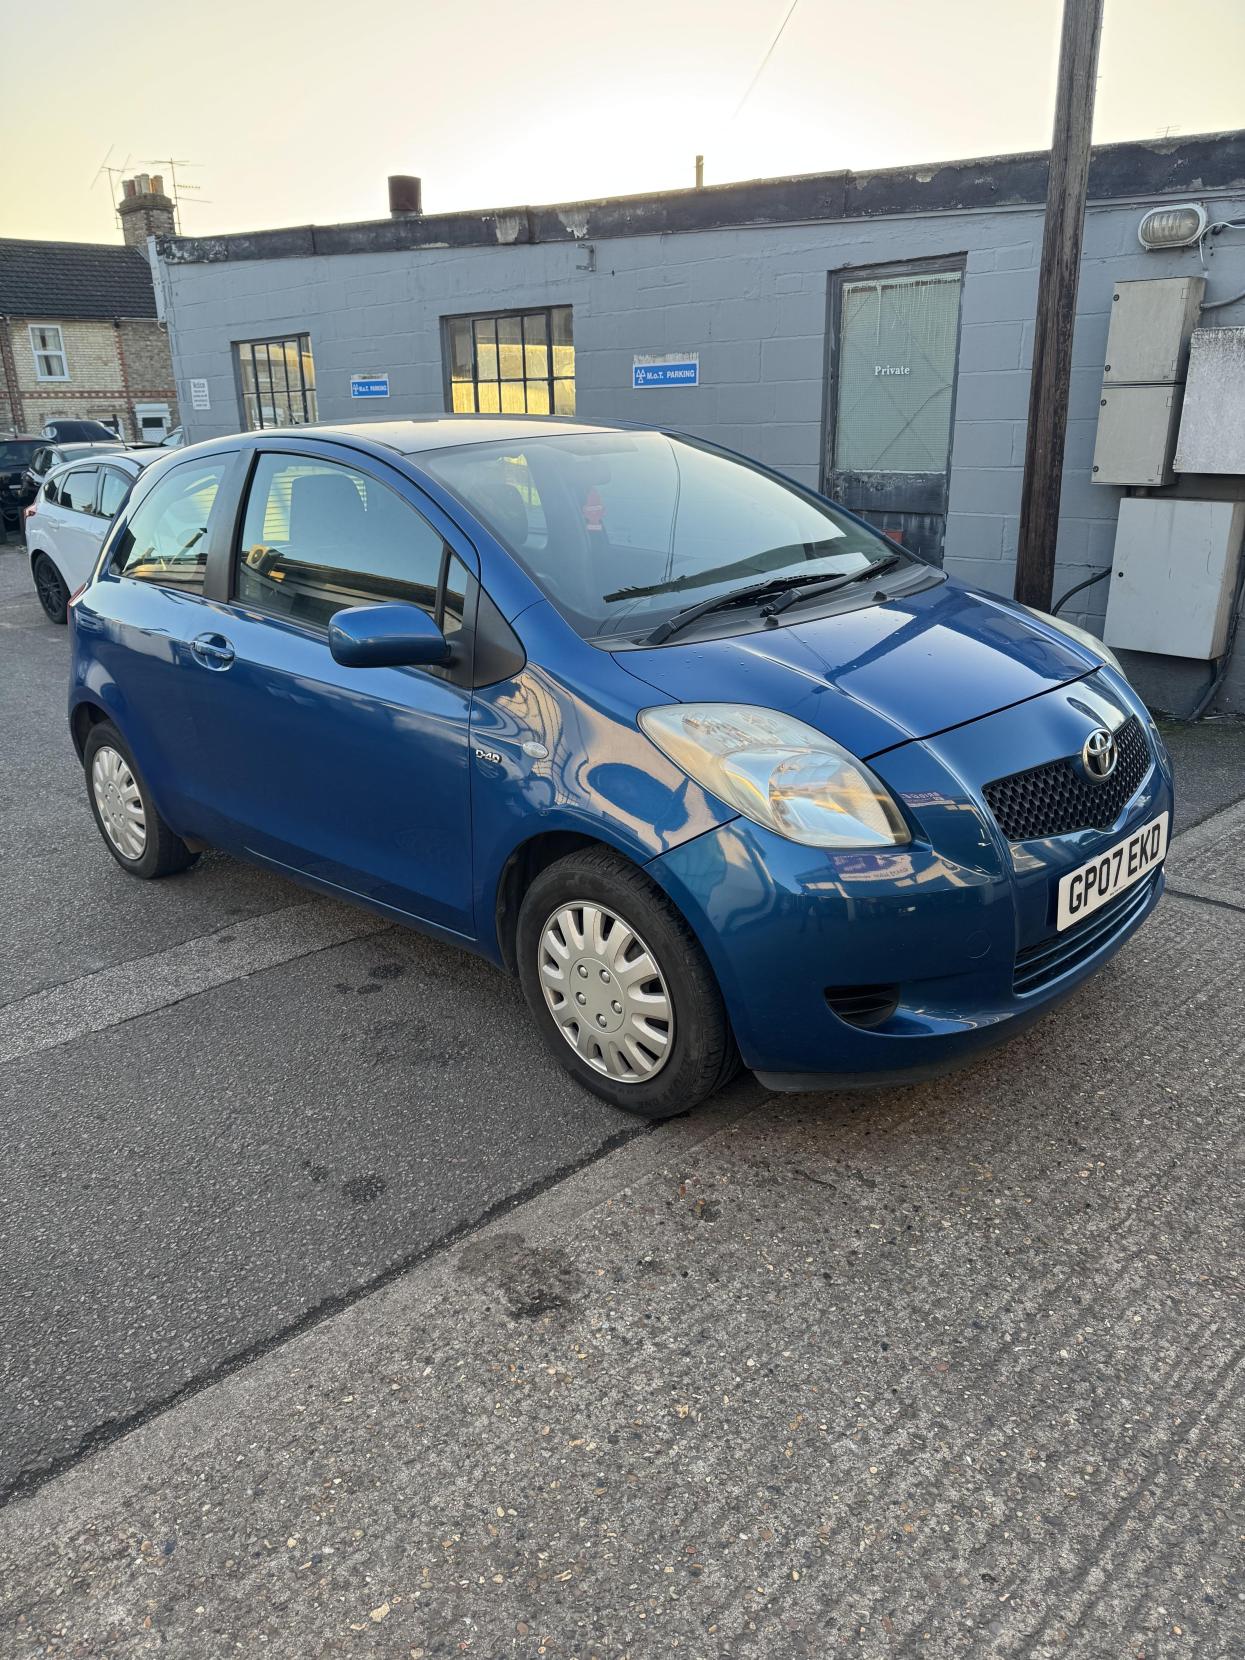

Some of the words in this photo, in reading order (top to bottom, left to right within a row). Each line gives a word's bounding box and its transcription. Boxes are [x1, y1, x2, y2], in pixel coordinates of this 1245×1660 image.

[666, 369, 695, 379] PARKING
[874, 365, 910, 376] Private
[1069, 847, 1124, 915] GP07
[1127, 823, 1161, 878] EKD
